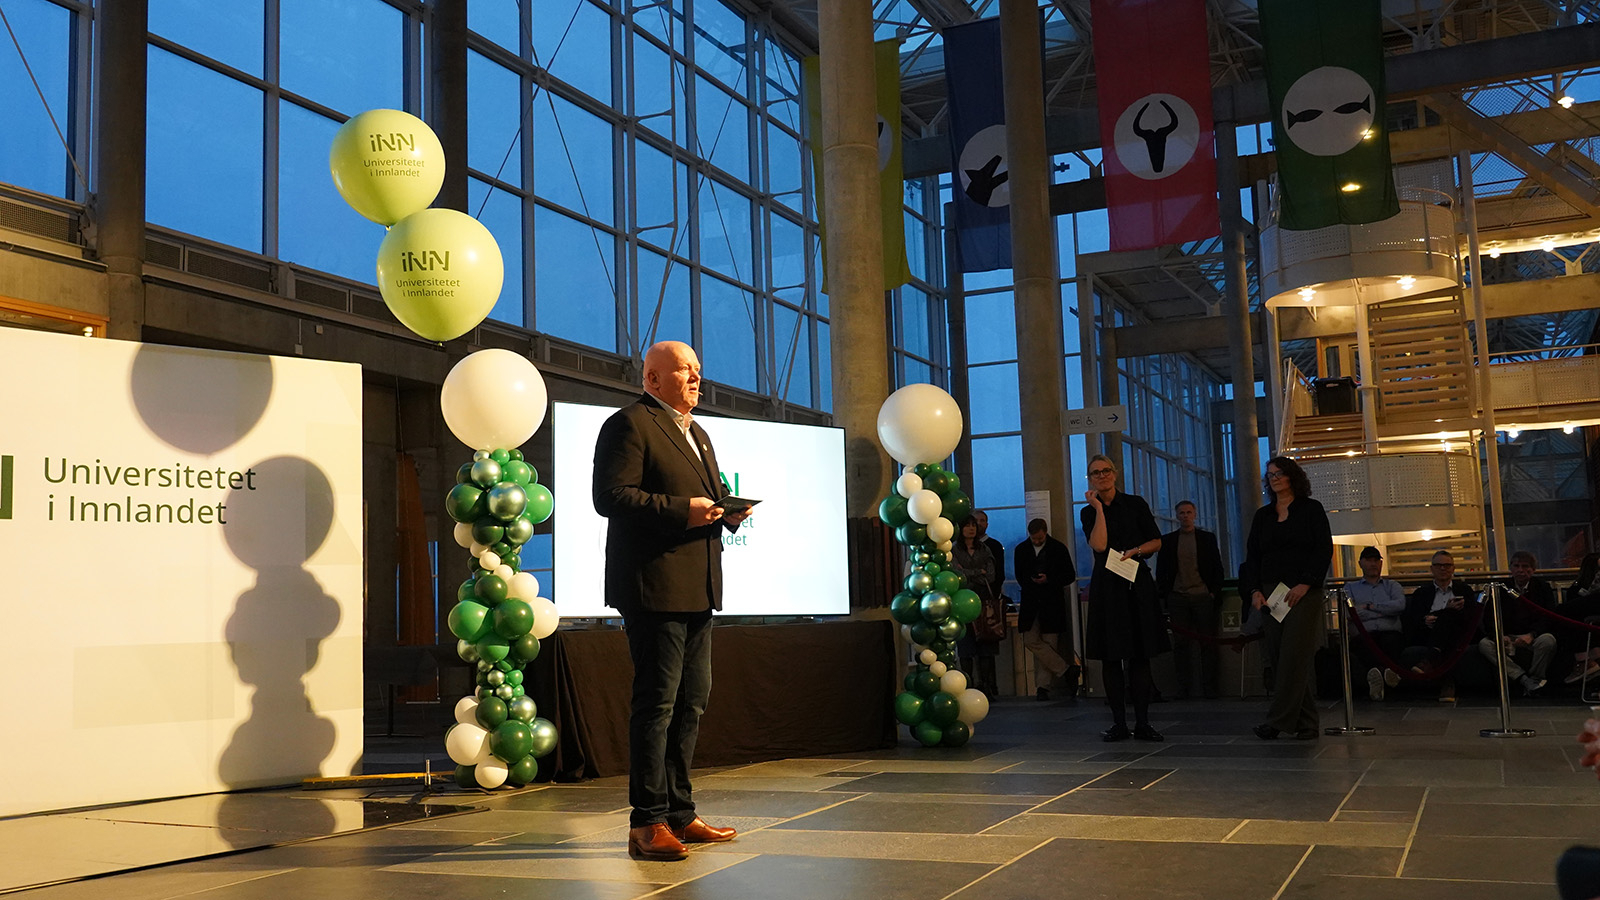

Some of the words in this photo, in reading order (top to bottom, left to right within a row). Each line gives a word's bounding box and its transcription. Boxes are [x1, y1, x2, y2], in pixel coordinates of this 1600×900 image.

[363, 158, 425, 168] Universitetet
[375, 168, 421, 178] Innlandet
[395, 278, 461, 288] Universitetet
[407, 288, 455, 298] Innlandet
[44, 457, 257, 491] Universitetet
[48, 494, 54, 521] i
[69, 496, 228, 524] Innlandet
